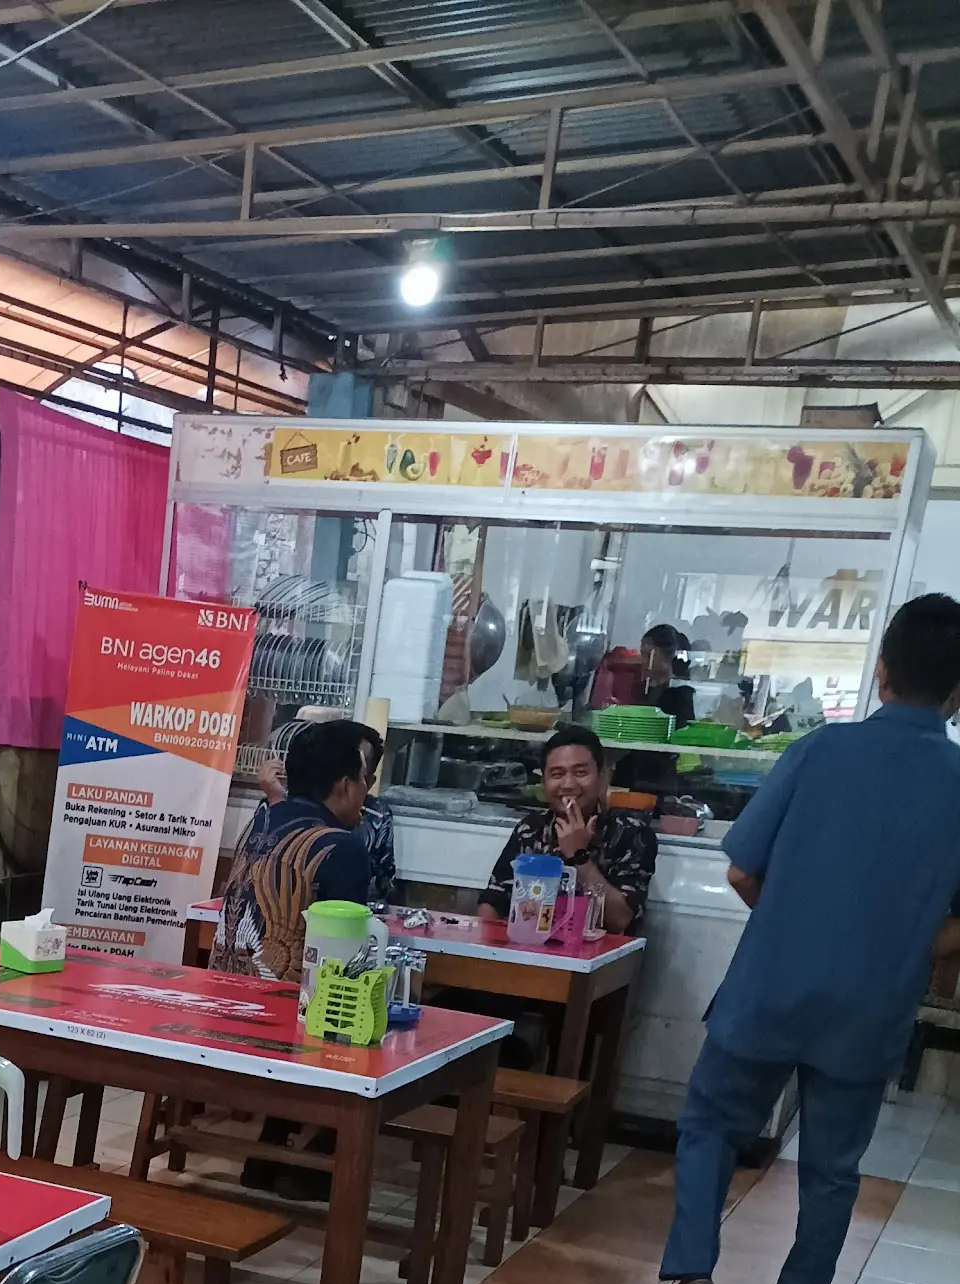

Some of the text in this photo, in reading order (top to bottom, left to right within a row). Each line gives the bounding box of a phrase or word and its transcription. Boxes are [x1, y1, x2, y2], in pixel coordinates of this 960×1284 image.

[286, 452, 312, 466] CAFE
[215, 610, 250, 632] BNI
[100, 636, 221, 669] BNI agen46
[152, 667, 175, 678] Paling
[177, 670, 199, 680] Dekat
[129, 701, 237, 738] WARKOP DOBI
[66, 732, 119, 753] MINI ATM
[153, 732, 232, 751] BNI0092030211
[71, 785, 148, 806] LAKU PANDAI
[65, 801, 213, 828] Buka Rekening Setor & Tarik Tunai
[63, 813, 196, 838] Pengajuan KUR Asuransi Mikro
[89, 837, 199, 860] LAYANAN KEUANGAN
[121, 853, 162, 868] DIGITAL
[77, 888, 172, 906] Isi Ulang Uang Elektronik
[74, 908, 112, 920] Pencairan
[113, 913, 145, 924] Bantuan
[76, 898, 178, 917] Tarik Tunai Uang Elektronik
[66, 926, 135, 944] EMBAYARAN
[110, 947, 135, 958] PDAM
[67, 1025, 79, 1034] 123
